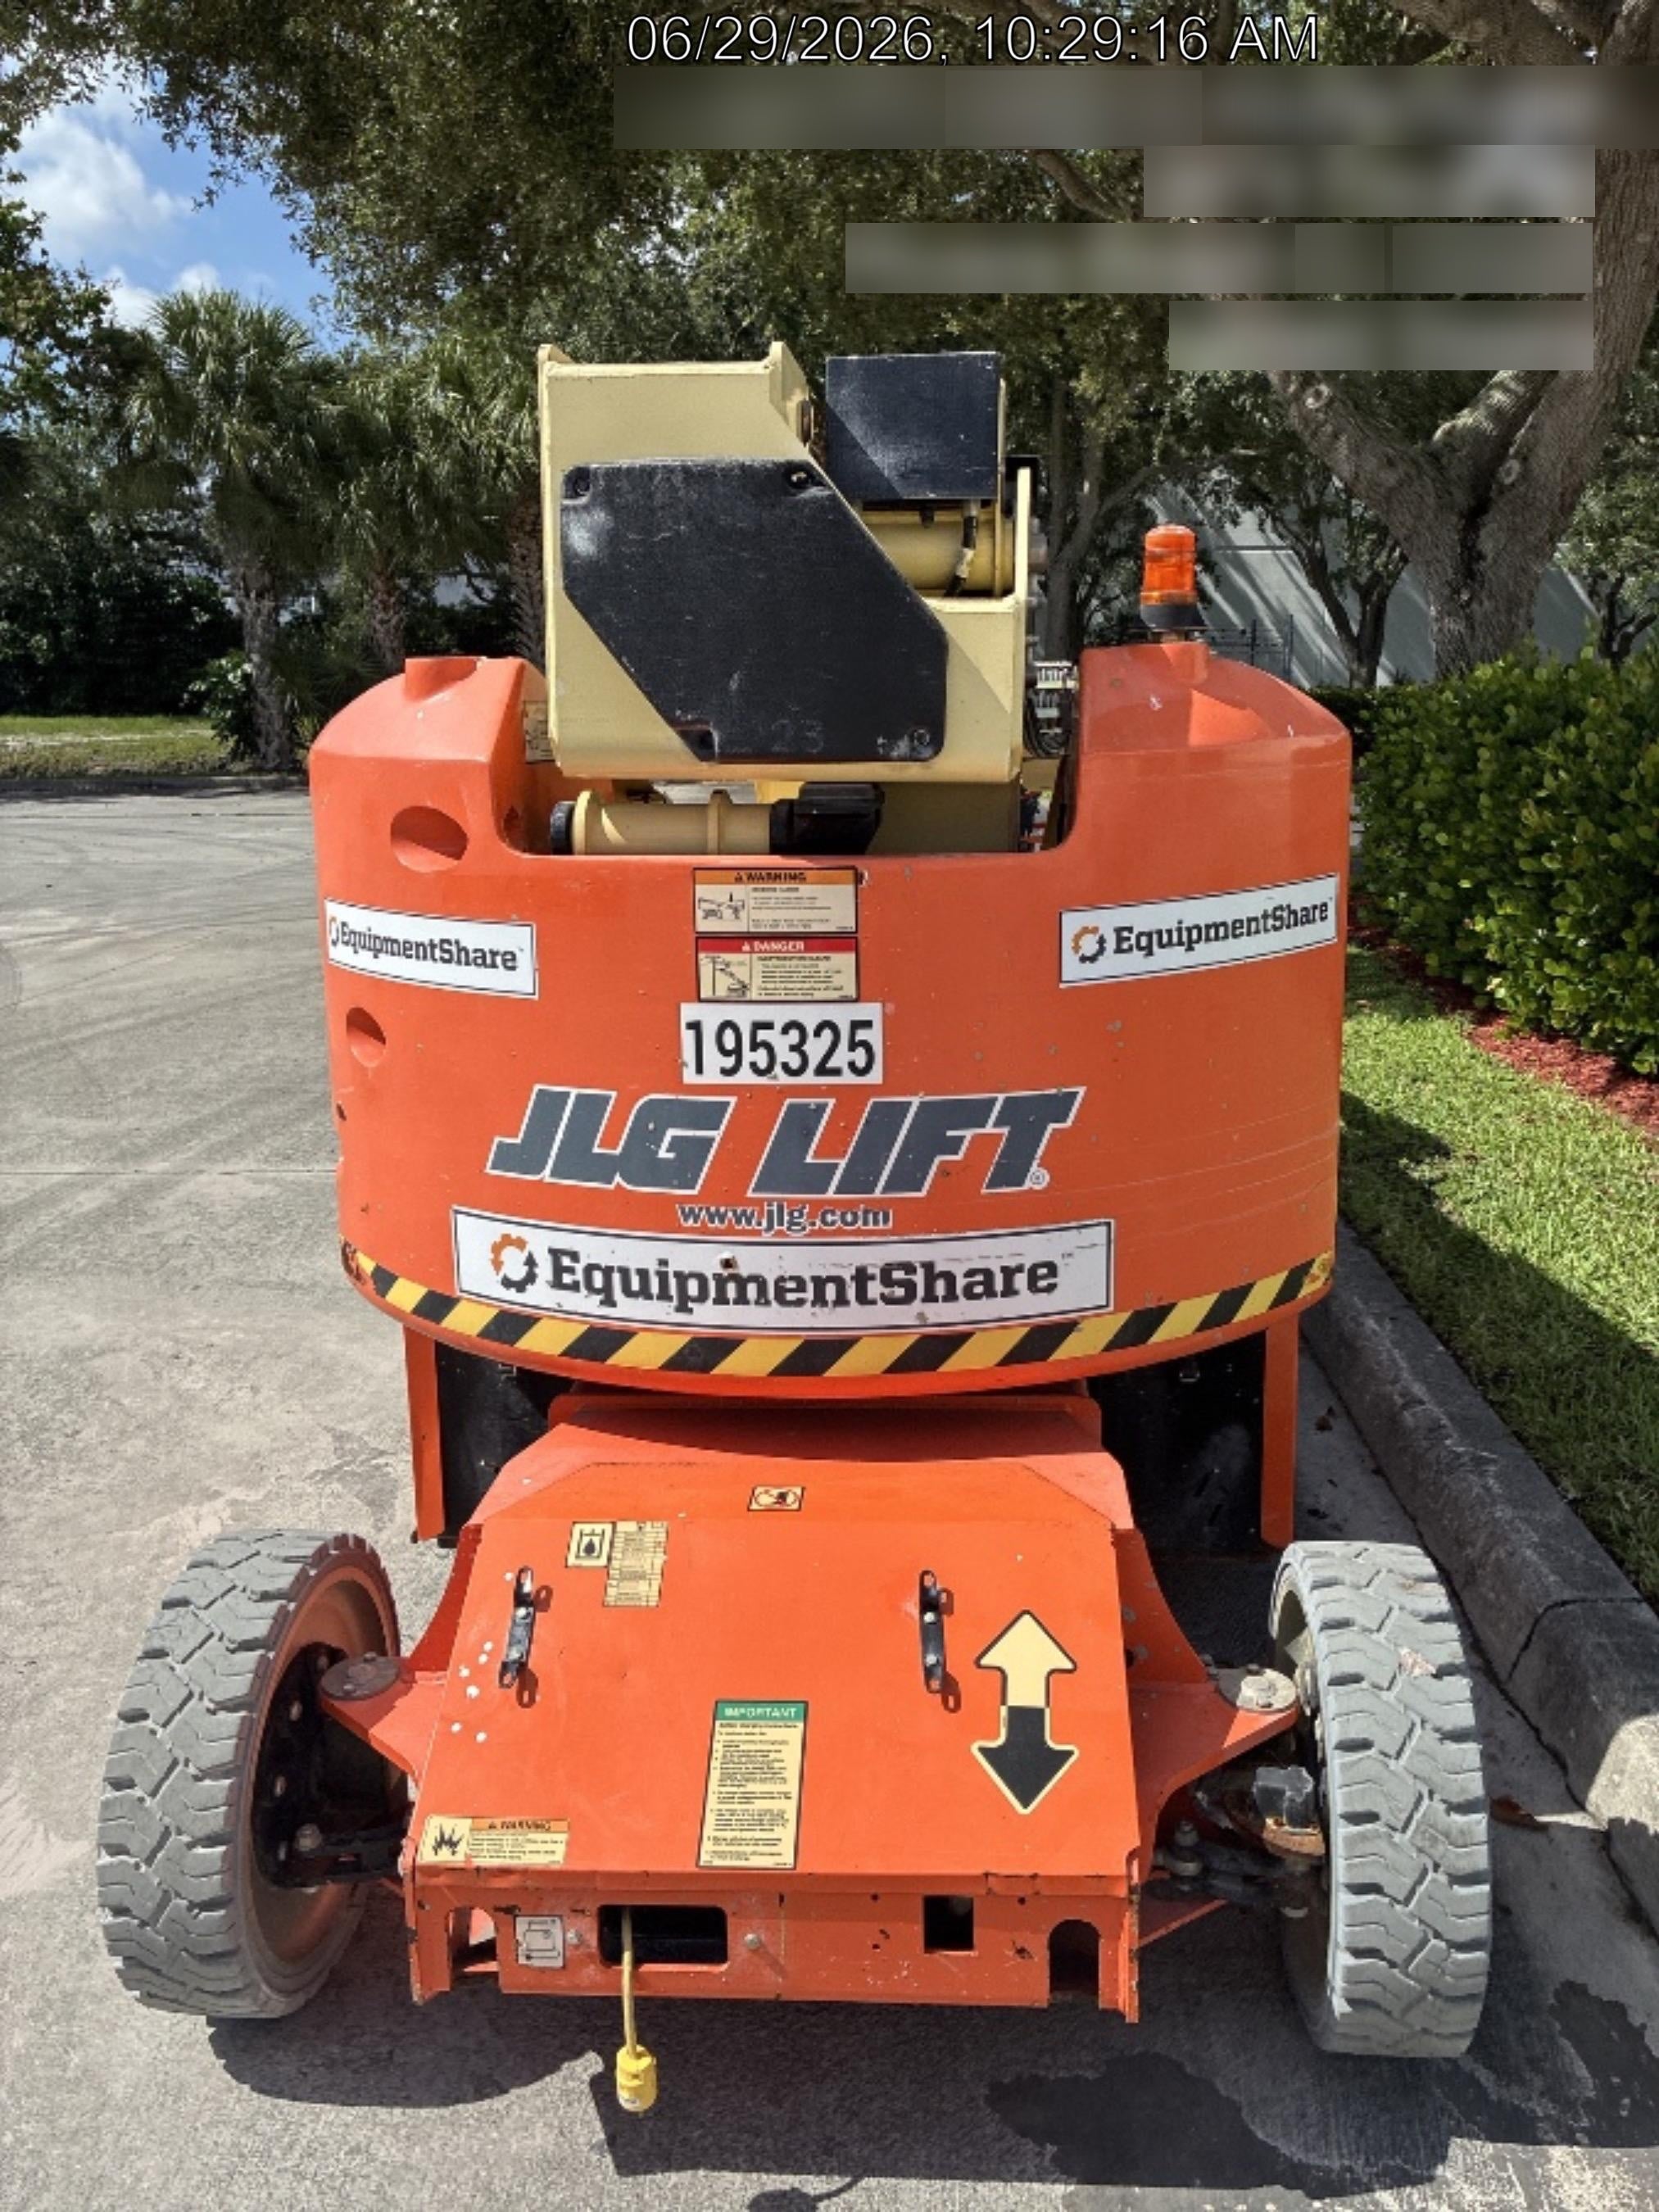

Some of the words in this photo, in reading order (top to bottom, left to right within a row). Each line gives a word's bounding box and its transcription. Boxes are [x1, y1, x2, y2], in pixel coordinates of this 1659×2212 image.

[746, 872, 807, 882] WARNING
[339, 920, 519, 972] EquipmentShare
[754, 941, 805, 952] DANGER
[1113, 900, 1330, 959] EquipmentShare
[685, 1019, 876, 1077] 195325
[485, 1083, 738, 1195] JLG
[677, 1202, 894, 1236] www.jlg.com
[546, 1246, 1058, 1315] EquipmentShare
[724, 1707, 797, 1719] IMPORTANT
